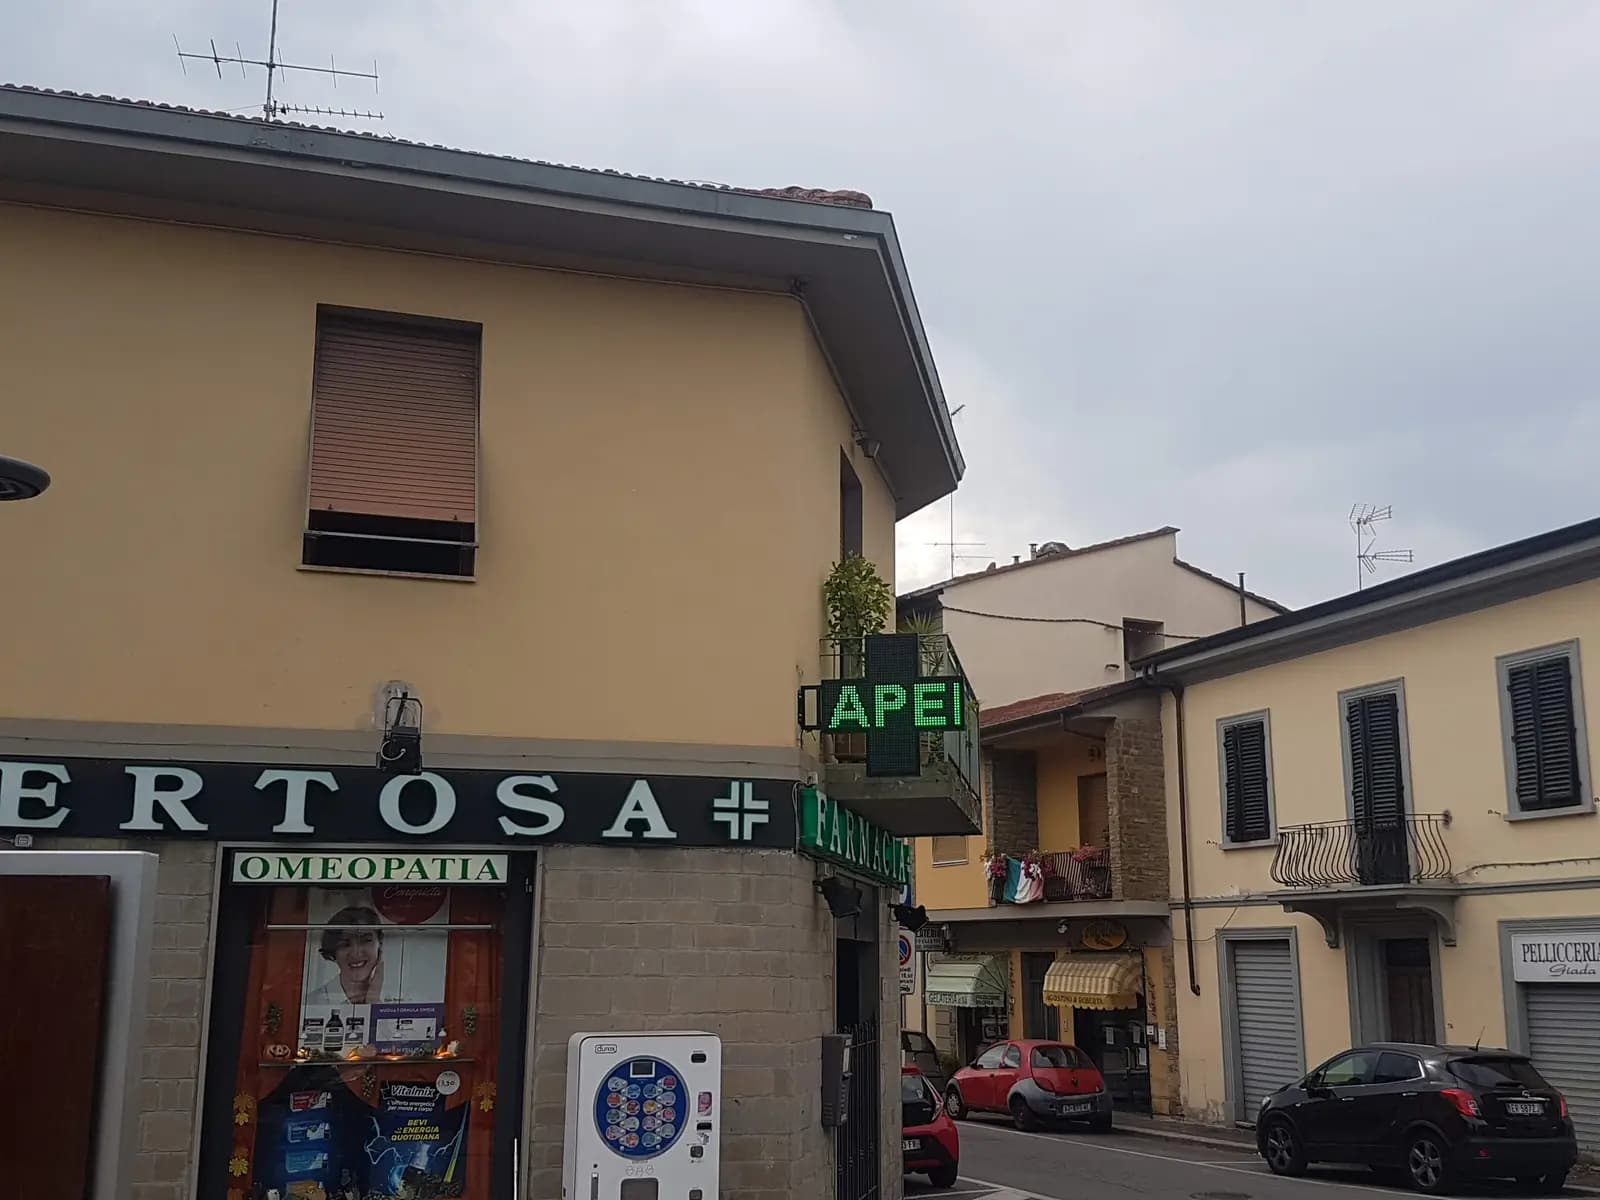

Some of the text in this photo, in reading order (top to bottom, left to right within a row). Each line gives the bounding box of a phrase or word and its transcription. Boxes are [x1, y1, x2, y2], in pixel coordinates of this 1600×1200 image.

[0, 761, 677, 839] ERTOSA
[815, 789, 907, 883] FARMACIA
[239, 856, 500, 881] OMEOPATIA
[1521, 942, 1600, 963] PELLICCERI
[1548, 963, 1597, 977] Giada
[391, 1084, 436, 1098] Vitalmix
[391, 1133, 440, 1141] QUOTIDIANA
[402, 1126, 440, 1134] ENERGIA
